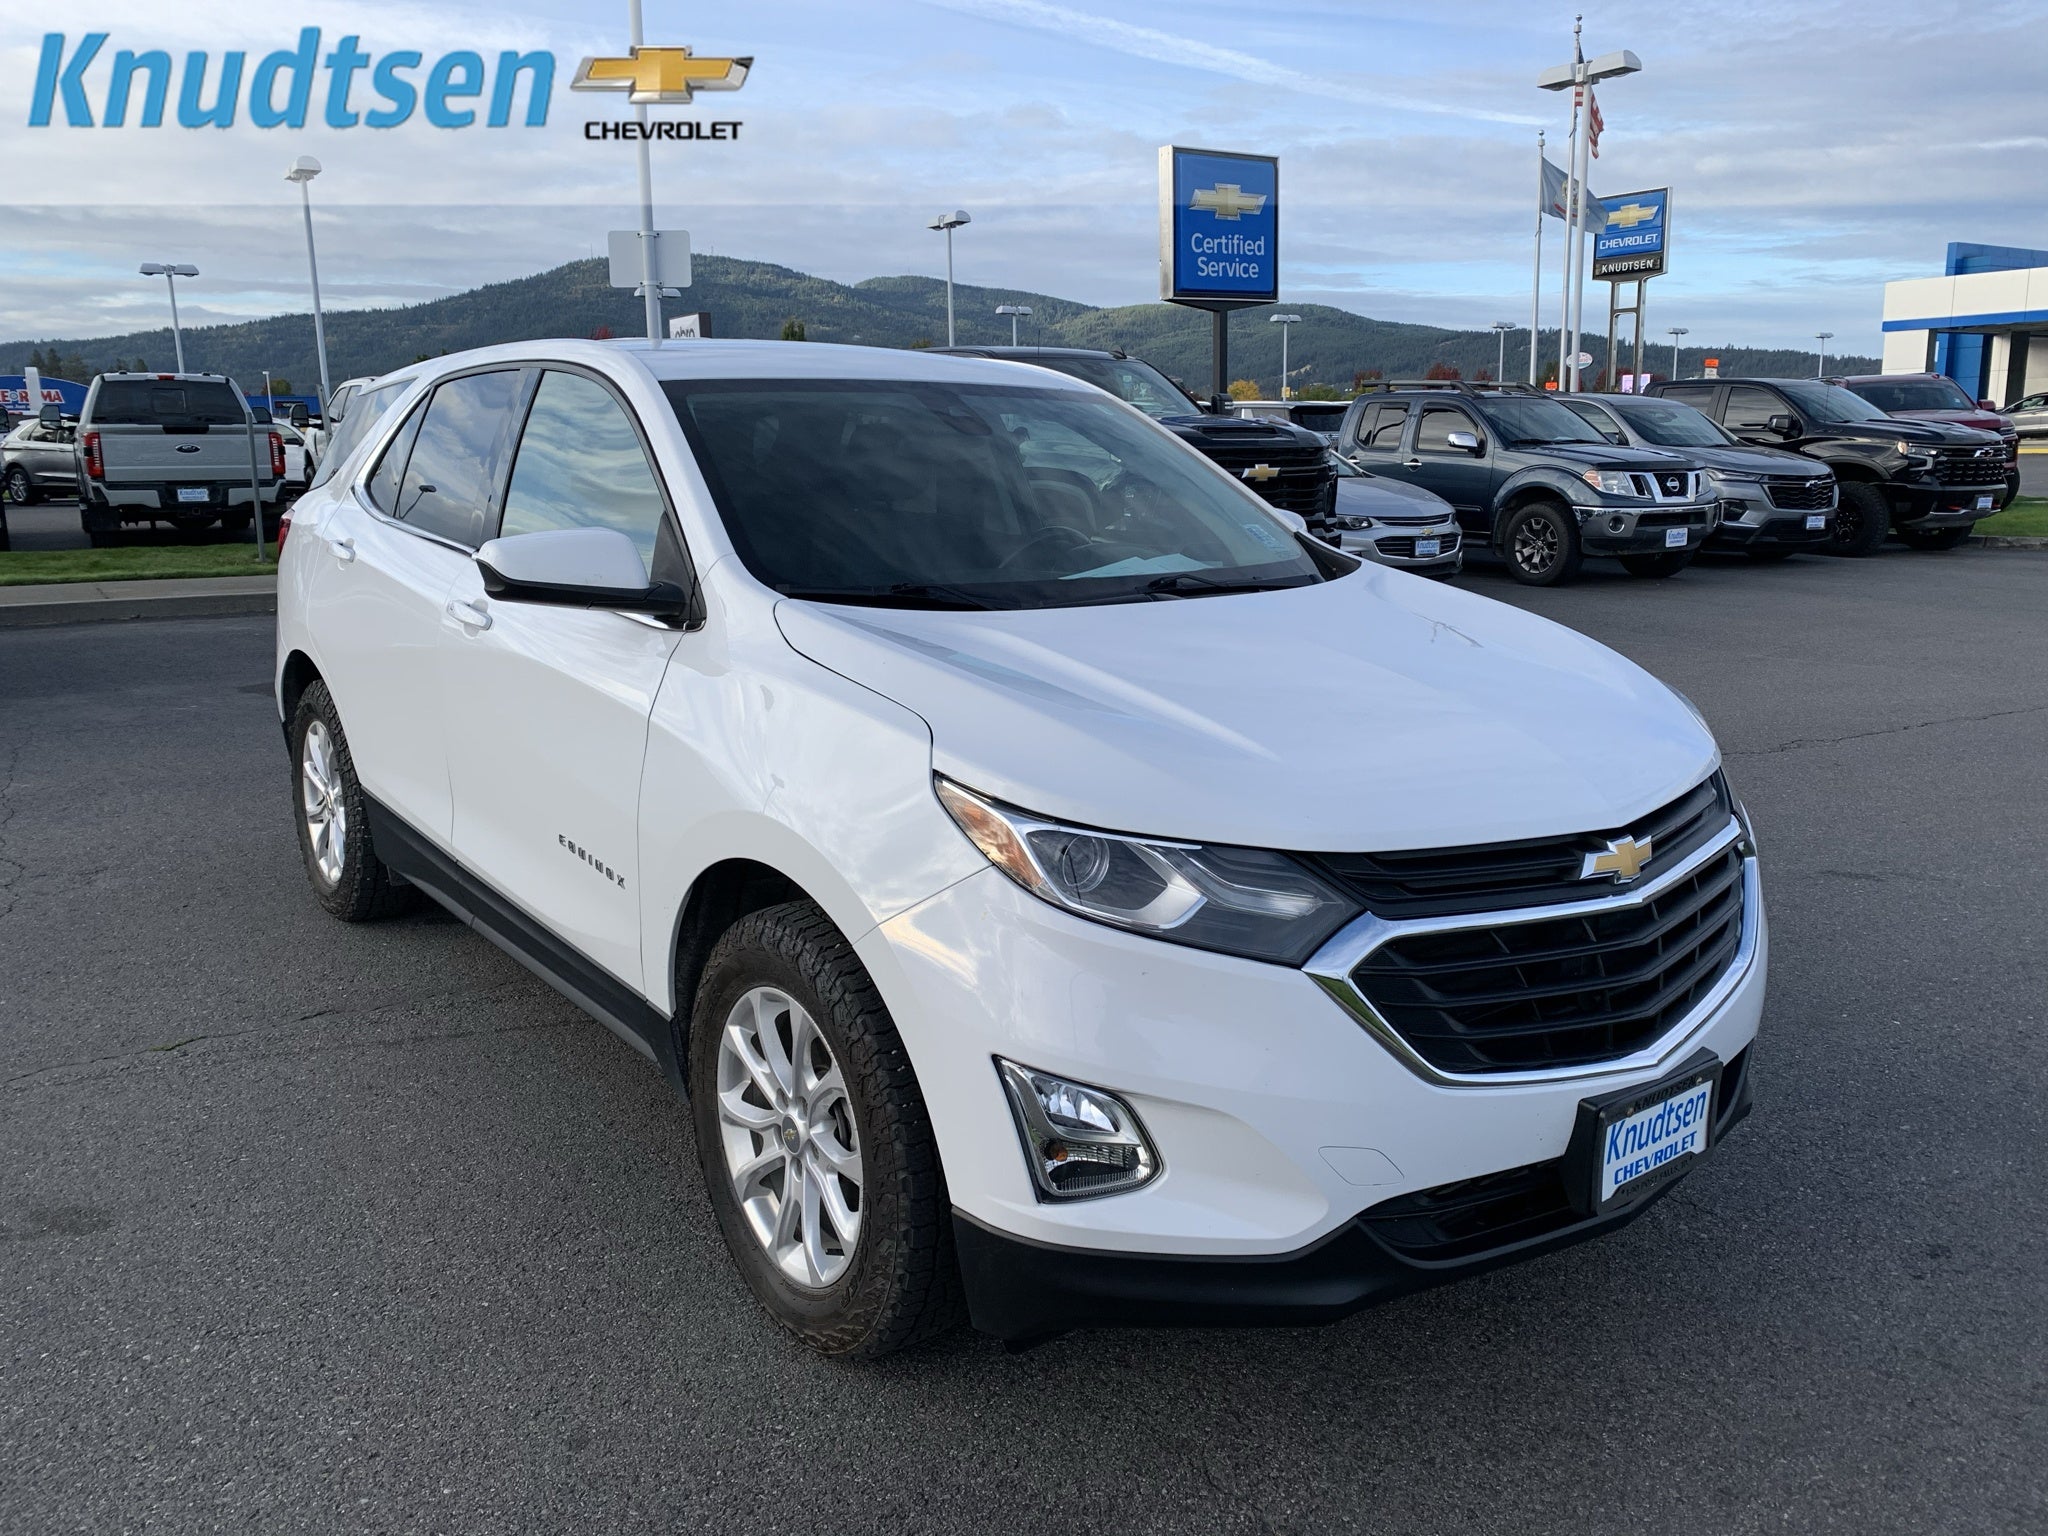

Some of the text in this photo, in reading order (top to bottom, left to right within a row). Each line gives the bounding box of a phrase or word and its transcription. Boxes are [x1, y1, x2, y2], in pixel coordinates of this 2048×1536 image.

[1191, 232, 1264, 255] Certified
[1600, 234, 1658, 250] CHEVROLET
[1197, 256, 1259, 278] Service
[1601, 259, 1655, 274] KNUDTSEN
[559, 834, 625, 890] EQUINOX
[1607, 1091, 1707, 1165] Knudtsen
[1614, 1131, 1698, 1185] CHEVROLET
